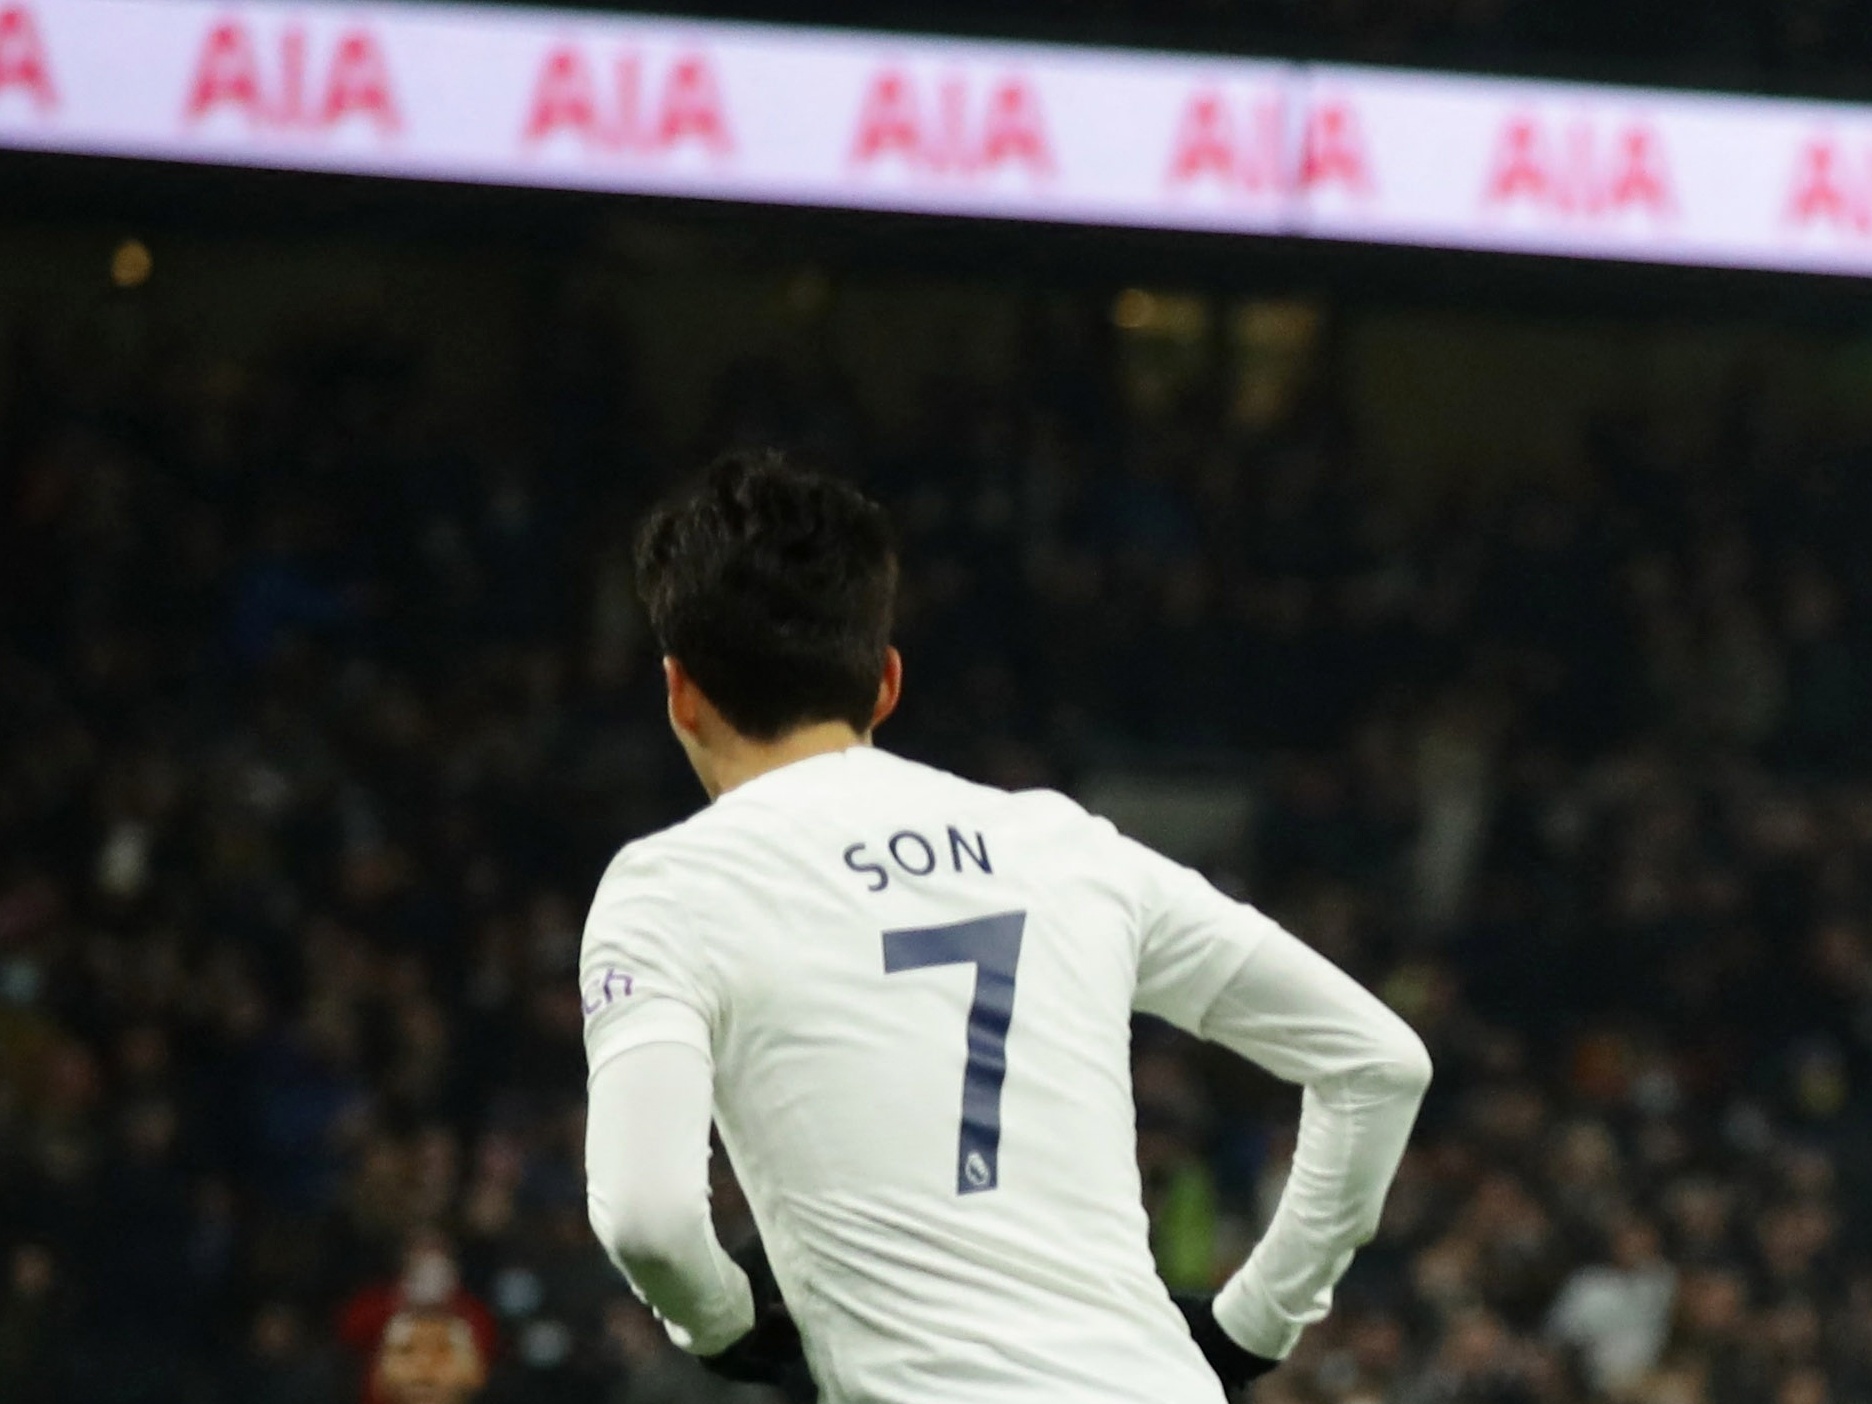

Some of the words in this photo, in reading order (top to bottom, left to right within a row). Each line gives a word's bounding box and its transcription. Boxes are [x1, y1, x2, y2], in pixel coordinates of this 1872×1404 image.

[182, 15, 403, 133] AIA
[522, 44, 733, 157] AIA
[850, 68, 1053, 179] AIA
[1168, 91, 1372, 198] AIA
[843, 824, 993, 892] SON
[880, 909, 1027, 1195] 7
